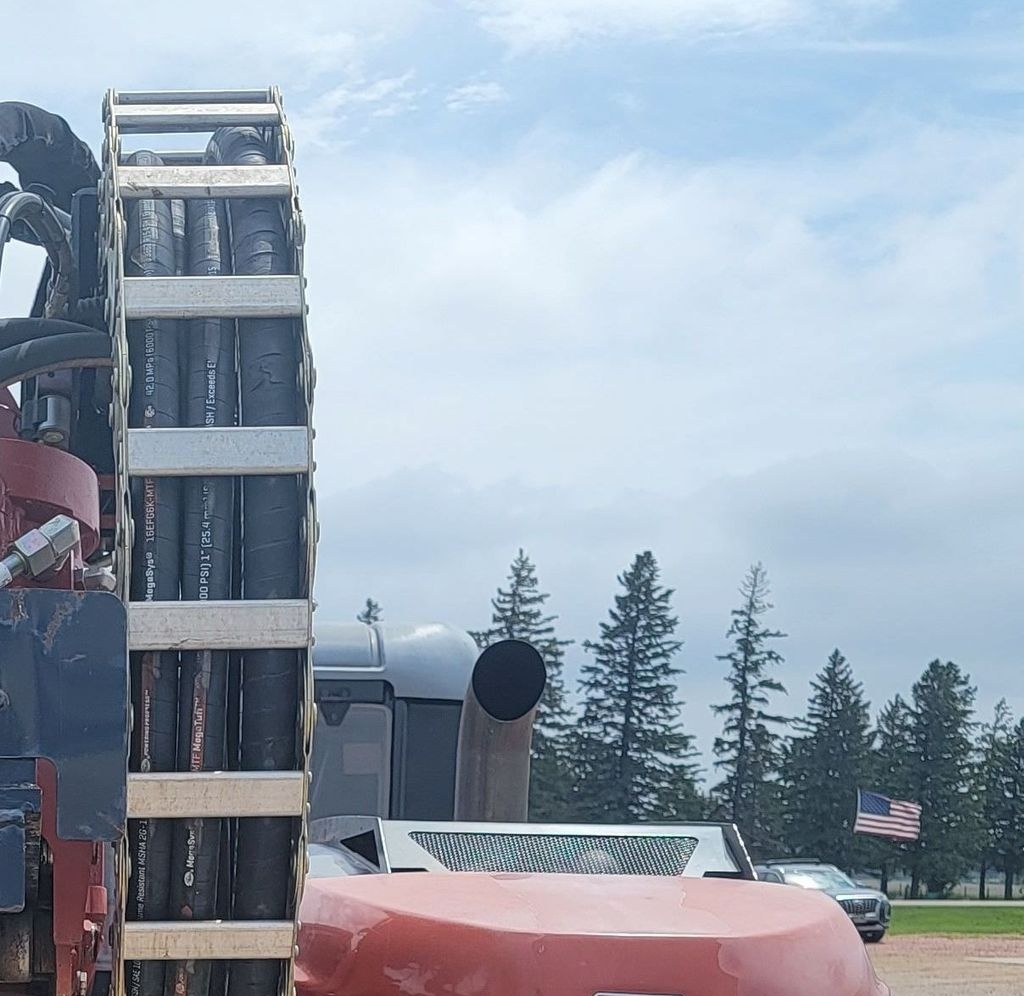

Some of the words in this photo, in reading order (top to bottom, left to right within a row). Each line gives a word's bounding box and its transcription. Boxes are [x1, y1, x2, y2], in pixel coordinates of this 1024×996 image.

[145, 358, 155, 375] MPa
[205, 370, 216, 404] Exceeds
[205, 412, 215, 426] SH
[201, 522, 213, 548] (25.4
[200, 563, 212, 584] PSI)
[138, 842, 147, 866] MSHA
[136, 866, 146, 903] Resistant
